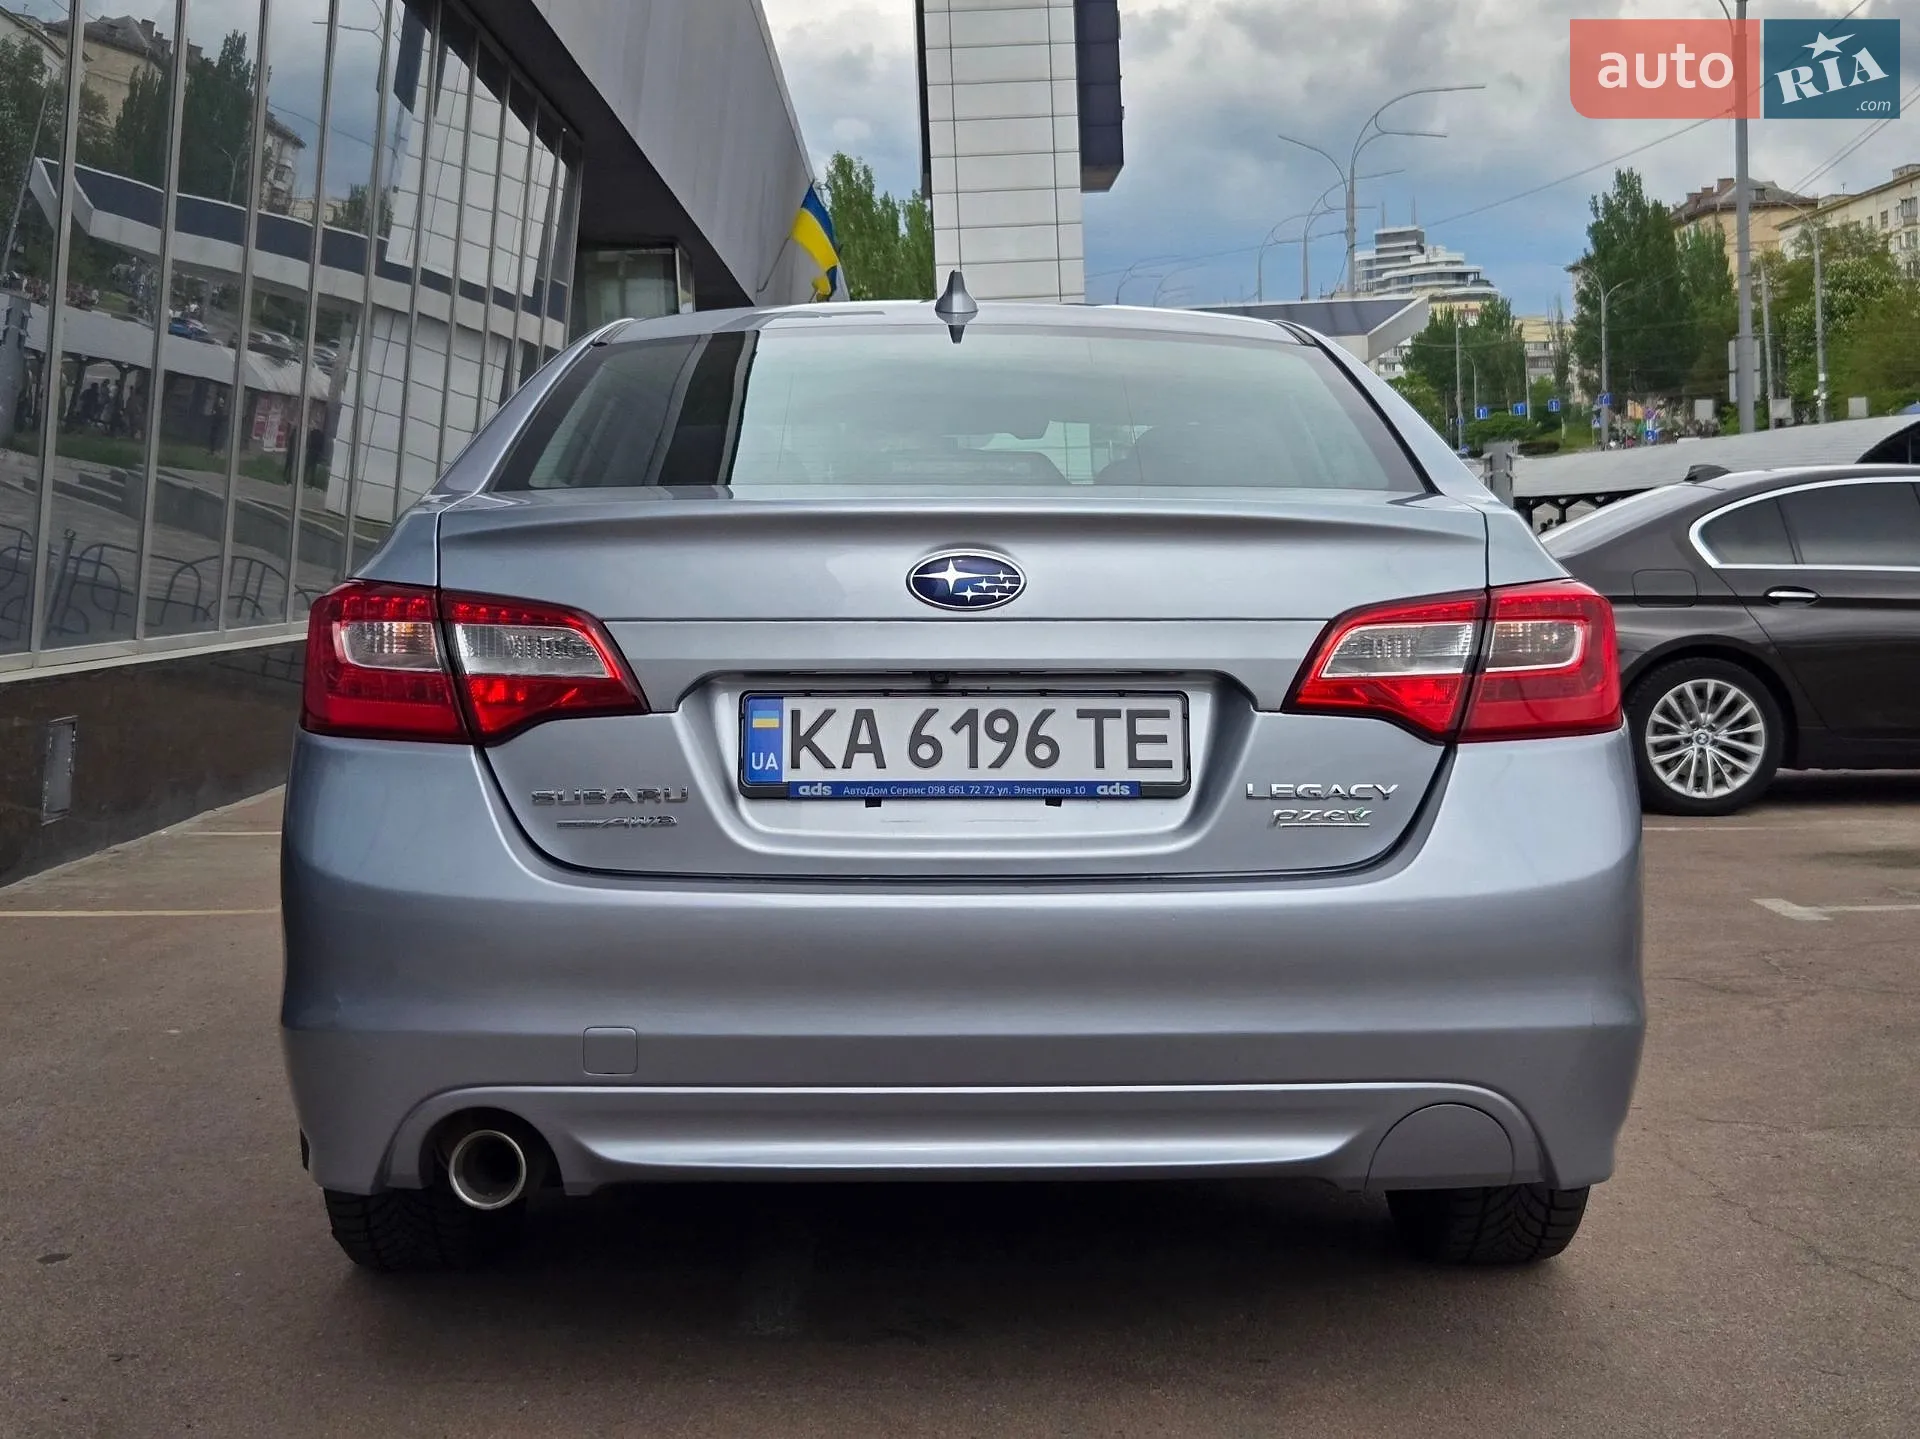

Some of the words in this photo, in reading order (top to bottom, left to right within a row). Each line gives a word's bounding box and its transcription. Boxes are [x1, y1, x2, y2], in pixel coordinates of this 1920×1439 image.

[790, 708, 887, 769] KA
[908, 708, 1060, 769] 6196
[1076, 708, 1173, 769] TE
[751, 752, 779, 770] UA
[531, 786, 689, 804] SUBARU
[798, 782, 832, 796] ads
[843, 785, 888, 797] АвтоДом
[890, 785, 925, 797] Сервис
[927, 785, 945, 795] 098
[948, 785, 965, 795] 661
[969, 785, 981, 795] 72
[984, 785, 995, 795] 72
[997, 787, 1011, 797] ул.
[1013, 785, 1071, 797] Электриков
[1074, 785, 1086, 795] 10
[1096, 782, 1130, 796] ads
[1246, 783, 1399, 800] LEGACY
